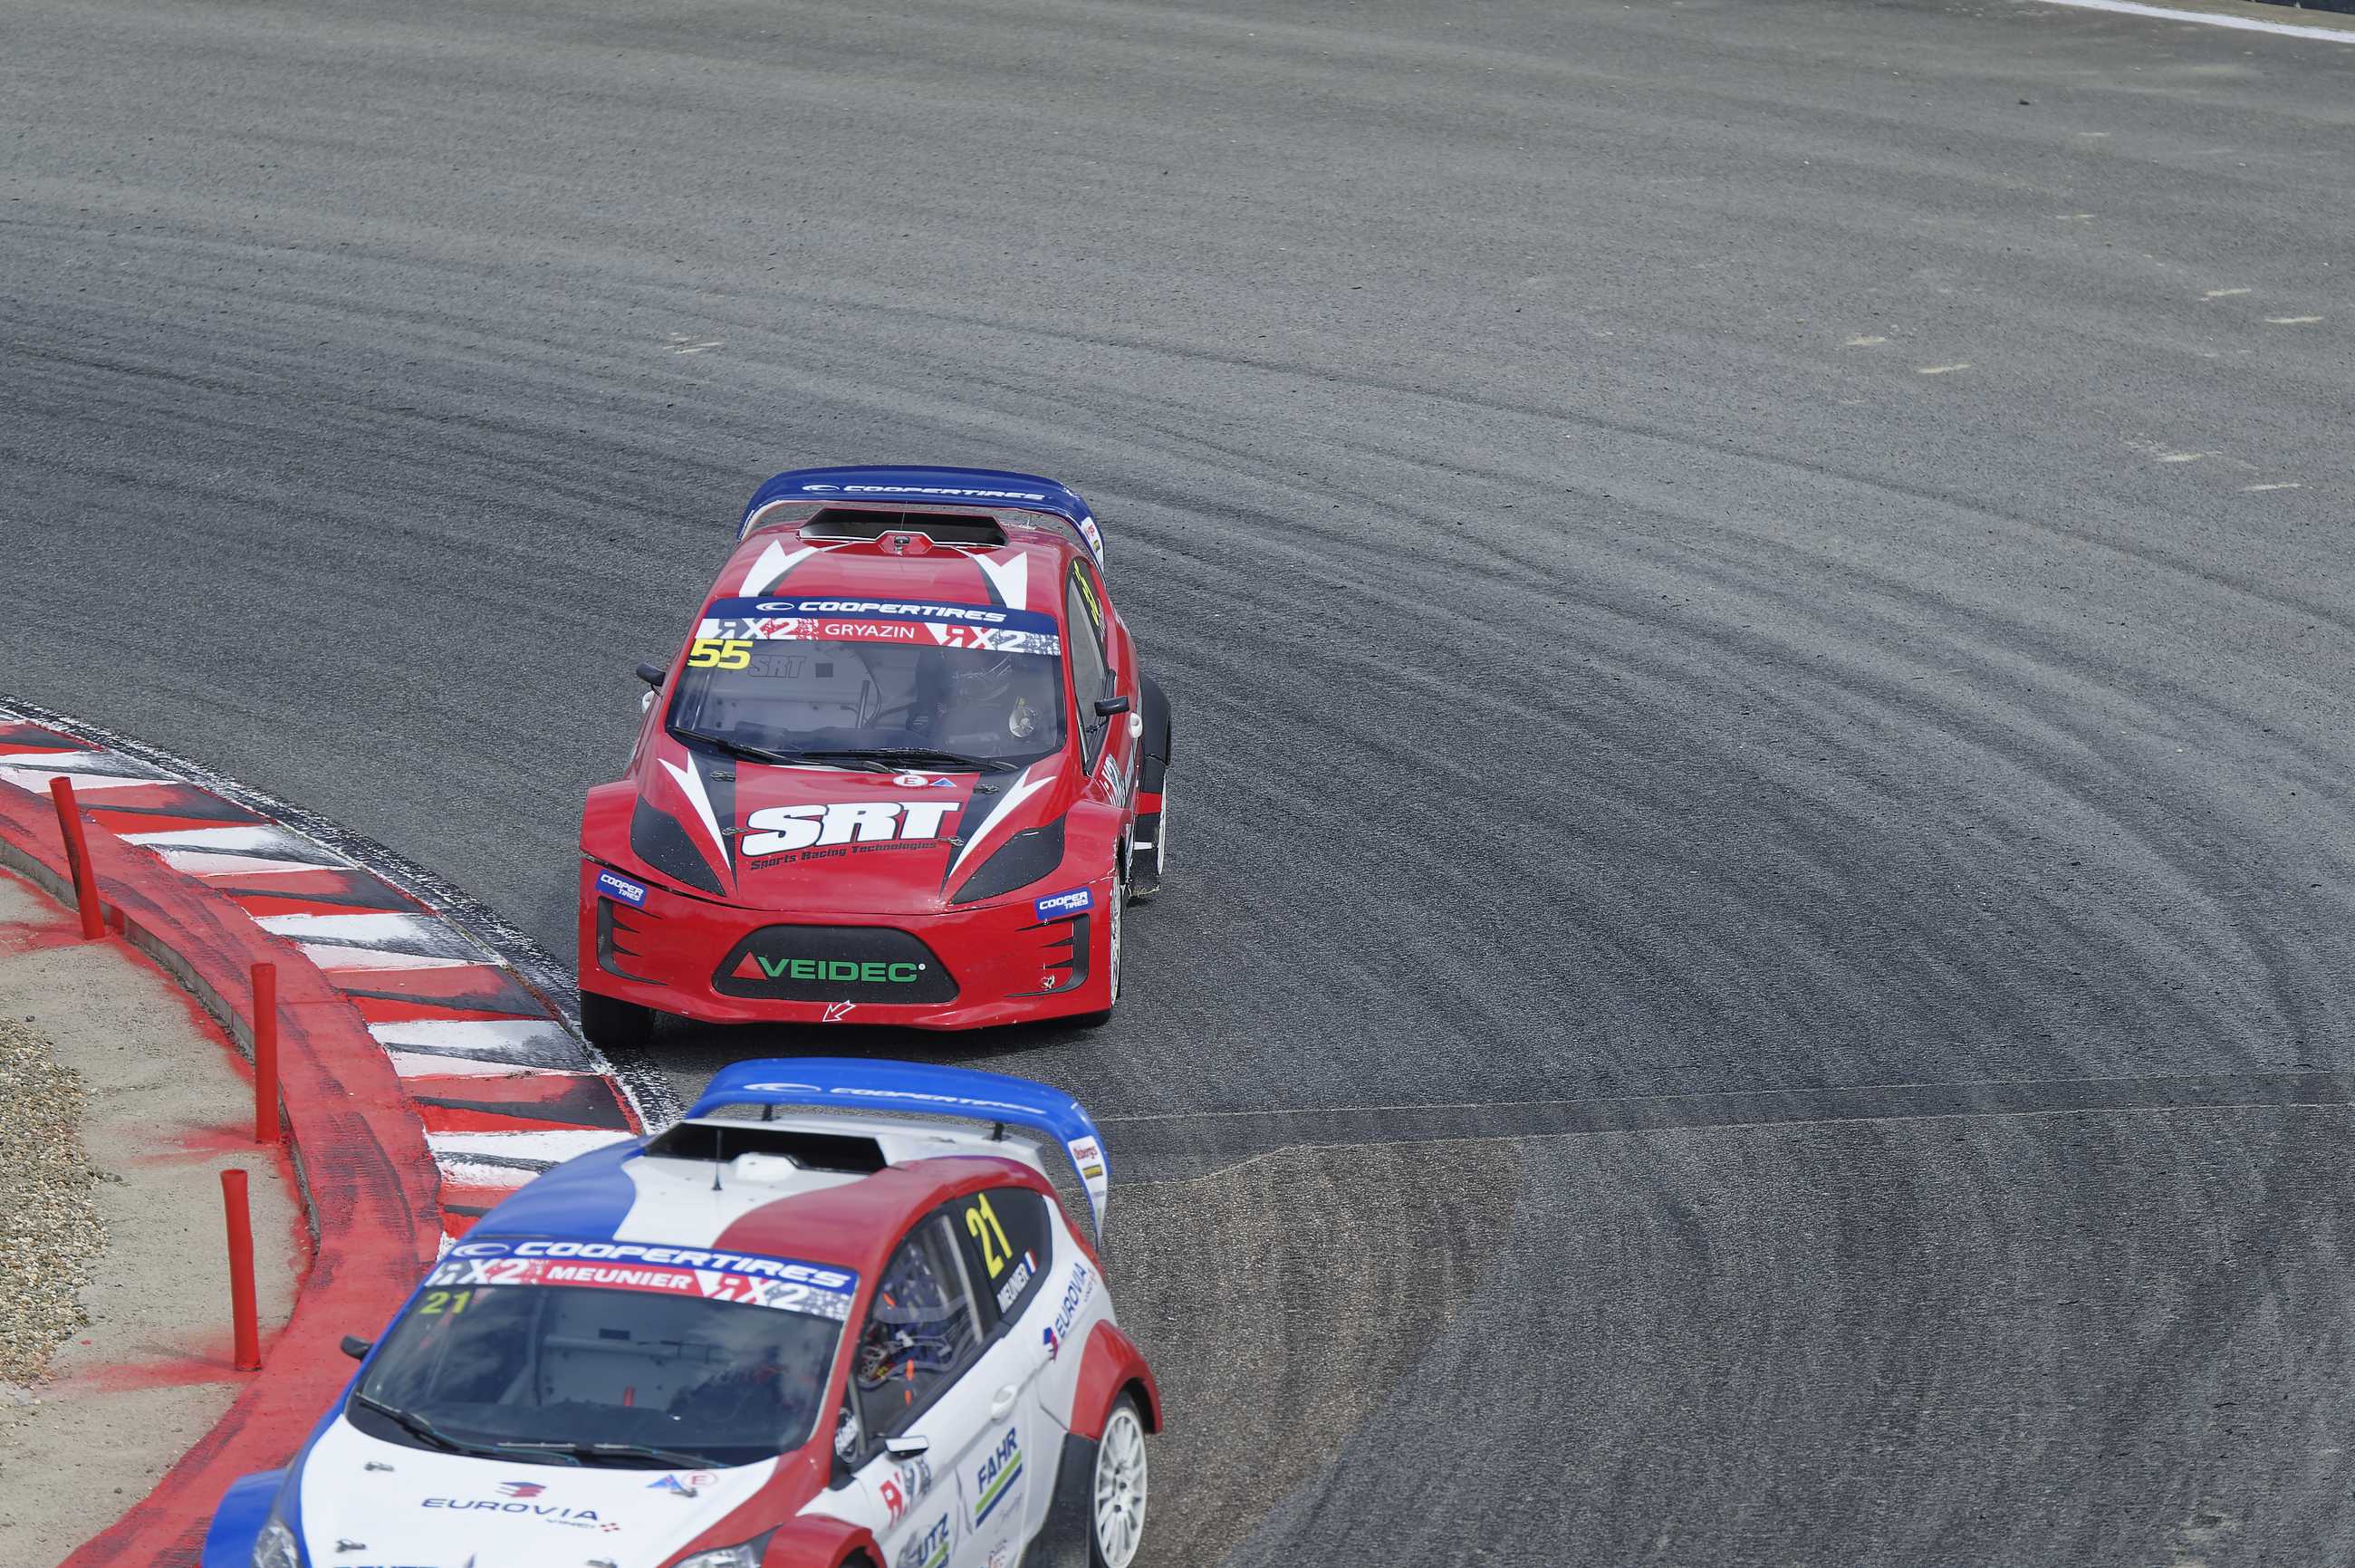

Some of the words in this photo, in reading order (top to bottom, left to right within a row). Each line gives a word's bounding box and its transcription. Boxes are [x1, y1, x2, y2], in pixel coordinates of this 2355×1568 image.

[798, 601, 1007, 623] COOPERTIRES
[824, 623, 916, 639] GRYAZIN
[687, 638, 755, 670] 55
[740, 802, 964, 858] SRT
[750, 853, 796, 870] Sports
[801, 848, 847, 861] Racing
[600, 873, 644, 897] COOPER
[617, 888, 641, 902] TIRES
[1039, 890, 1089, 910] COOPER
[1064, 899, 1089, 910] TIRES
[756, 956, 918, 983] VEIDEC
[965, 1192, 1014, 1280] 21
[514, 1241, 851, 1288] COOPERTIRES
[546, 1265, 694, 1290] MEUNIER
[419, 1290, 476, 1314] 21
[1054, 1262, 1088, 1340] EUROVIA
[976, 1427, 1018, 1495] FAHR
[420, 1497, 599, 1521] EUROVIA
